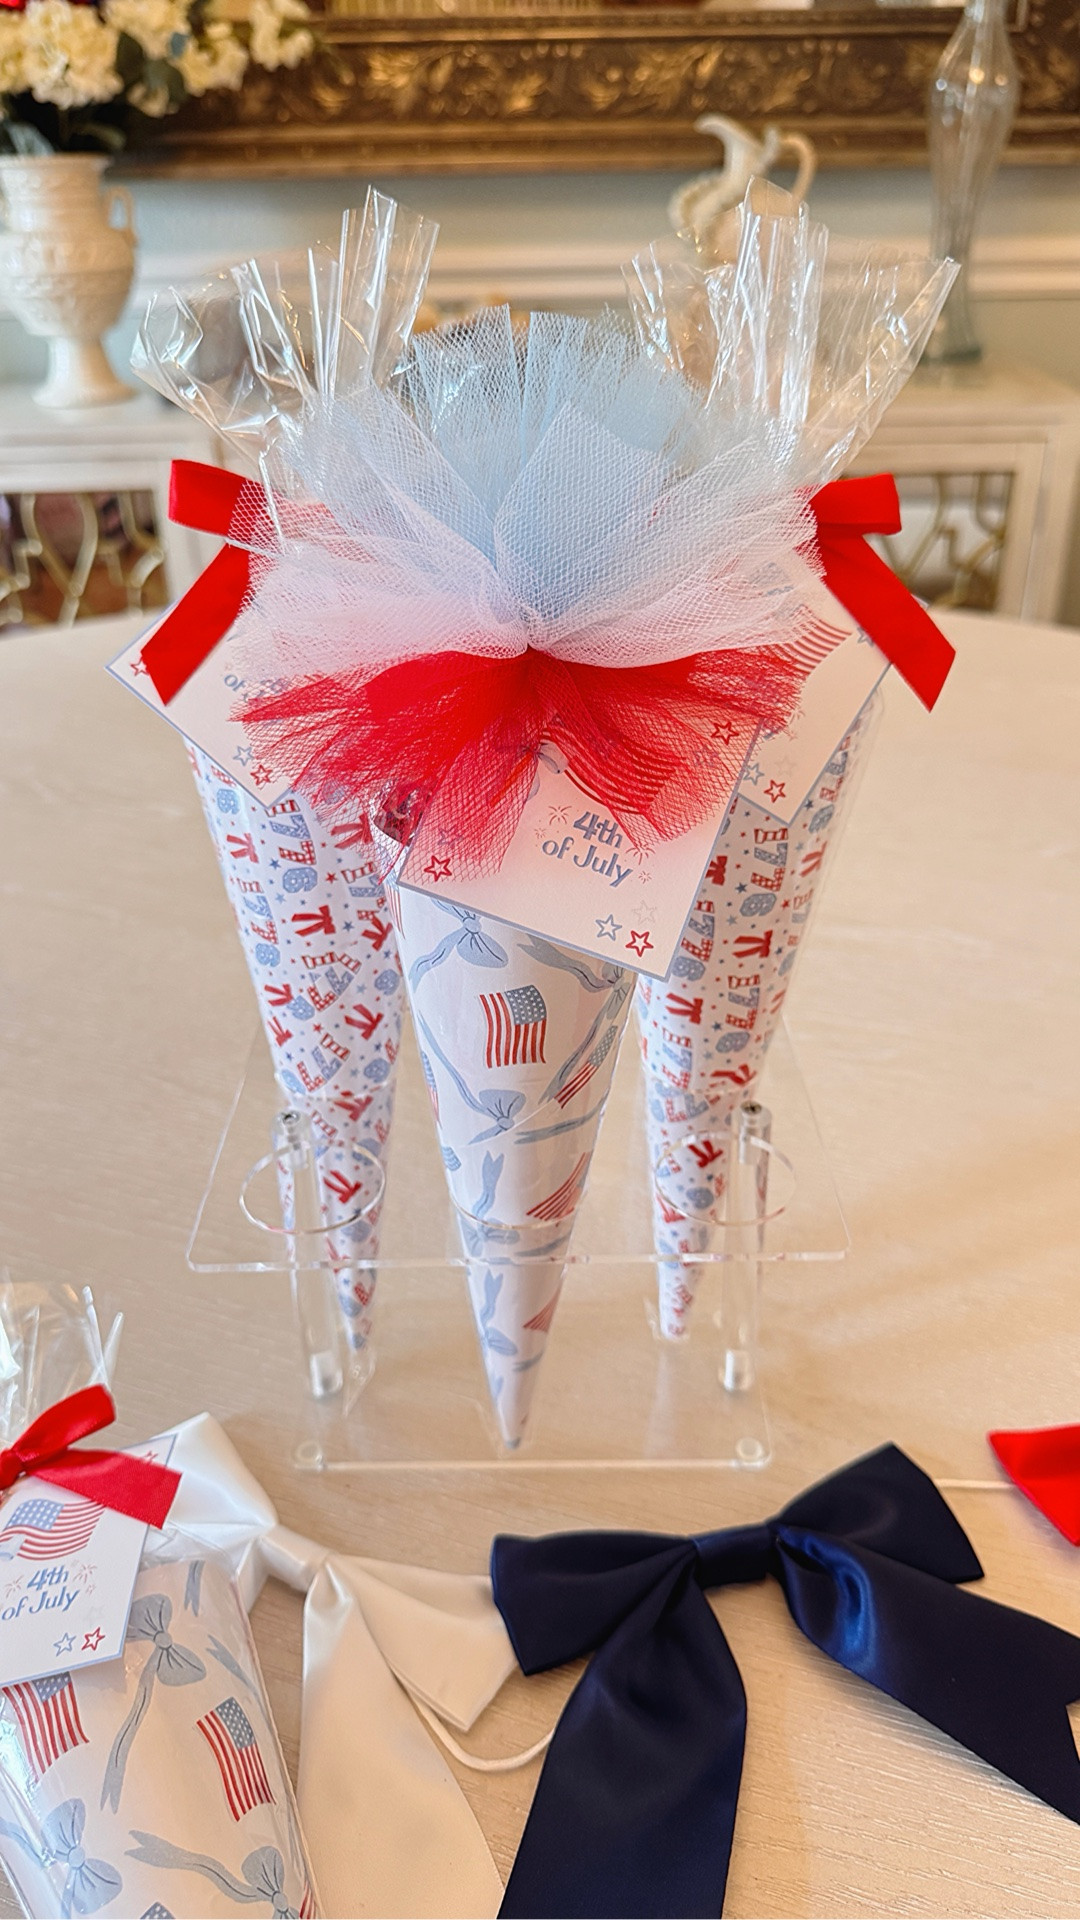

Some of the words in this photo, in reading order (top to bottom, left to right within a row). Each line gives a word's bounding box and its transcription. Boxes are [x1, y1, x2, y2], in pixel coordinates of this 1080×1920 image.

[573, 811, 623, 848] 4th
[542, 836, 575, 859] of
[573, 844, 634, 887] July
[740, 828, 788, 917] 1776
[236, 877, 281, 967] 1776
[715, 974, 760, 1054] 1776
[1, 1596, 29, 1621] of
[29, 1586, 80, 1614] July
[27, 1565, 69, 1591] 4th
